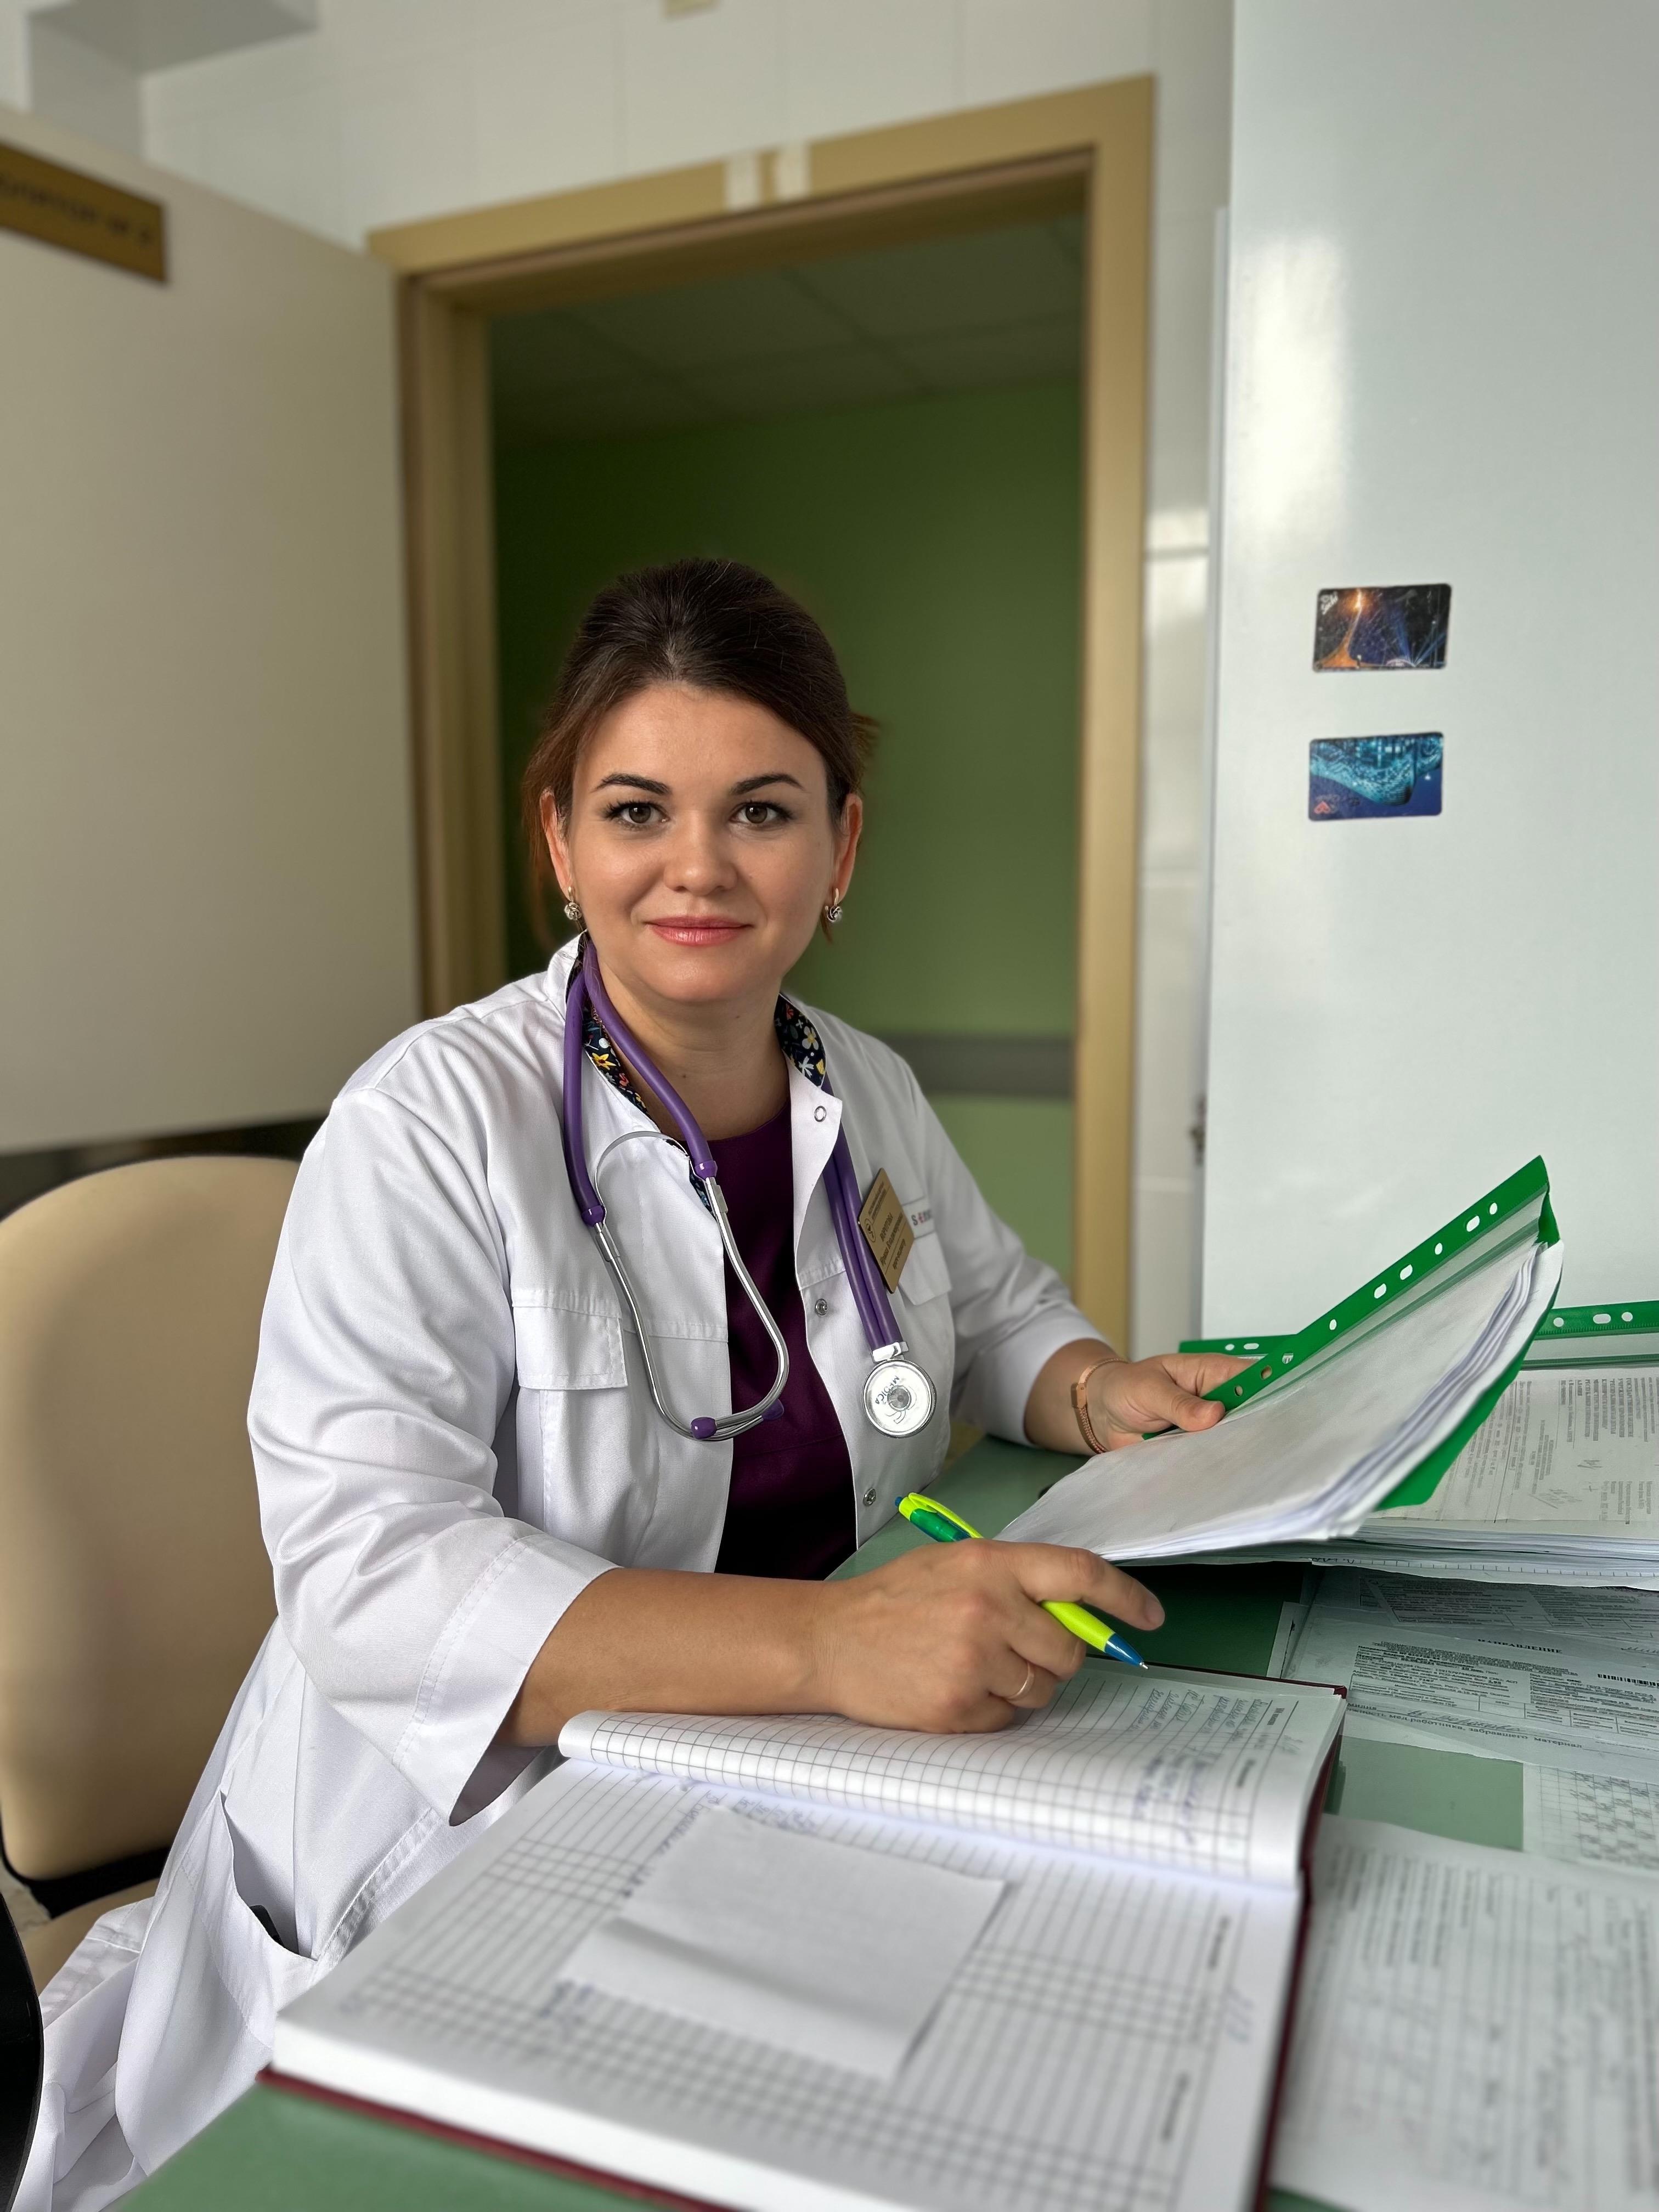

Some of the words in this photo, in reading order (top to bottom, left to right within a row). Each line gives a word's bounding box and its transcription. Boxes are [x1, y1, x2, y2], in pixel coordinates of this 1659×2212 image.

[875, 1375, 900, 1404] MEDICA
[1347, 1708, 1386, 1717] жность
[1534, 1737, 1582, 1748] материал
